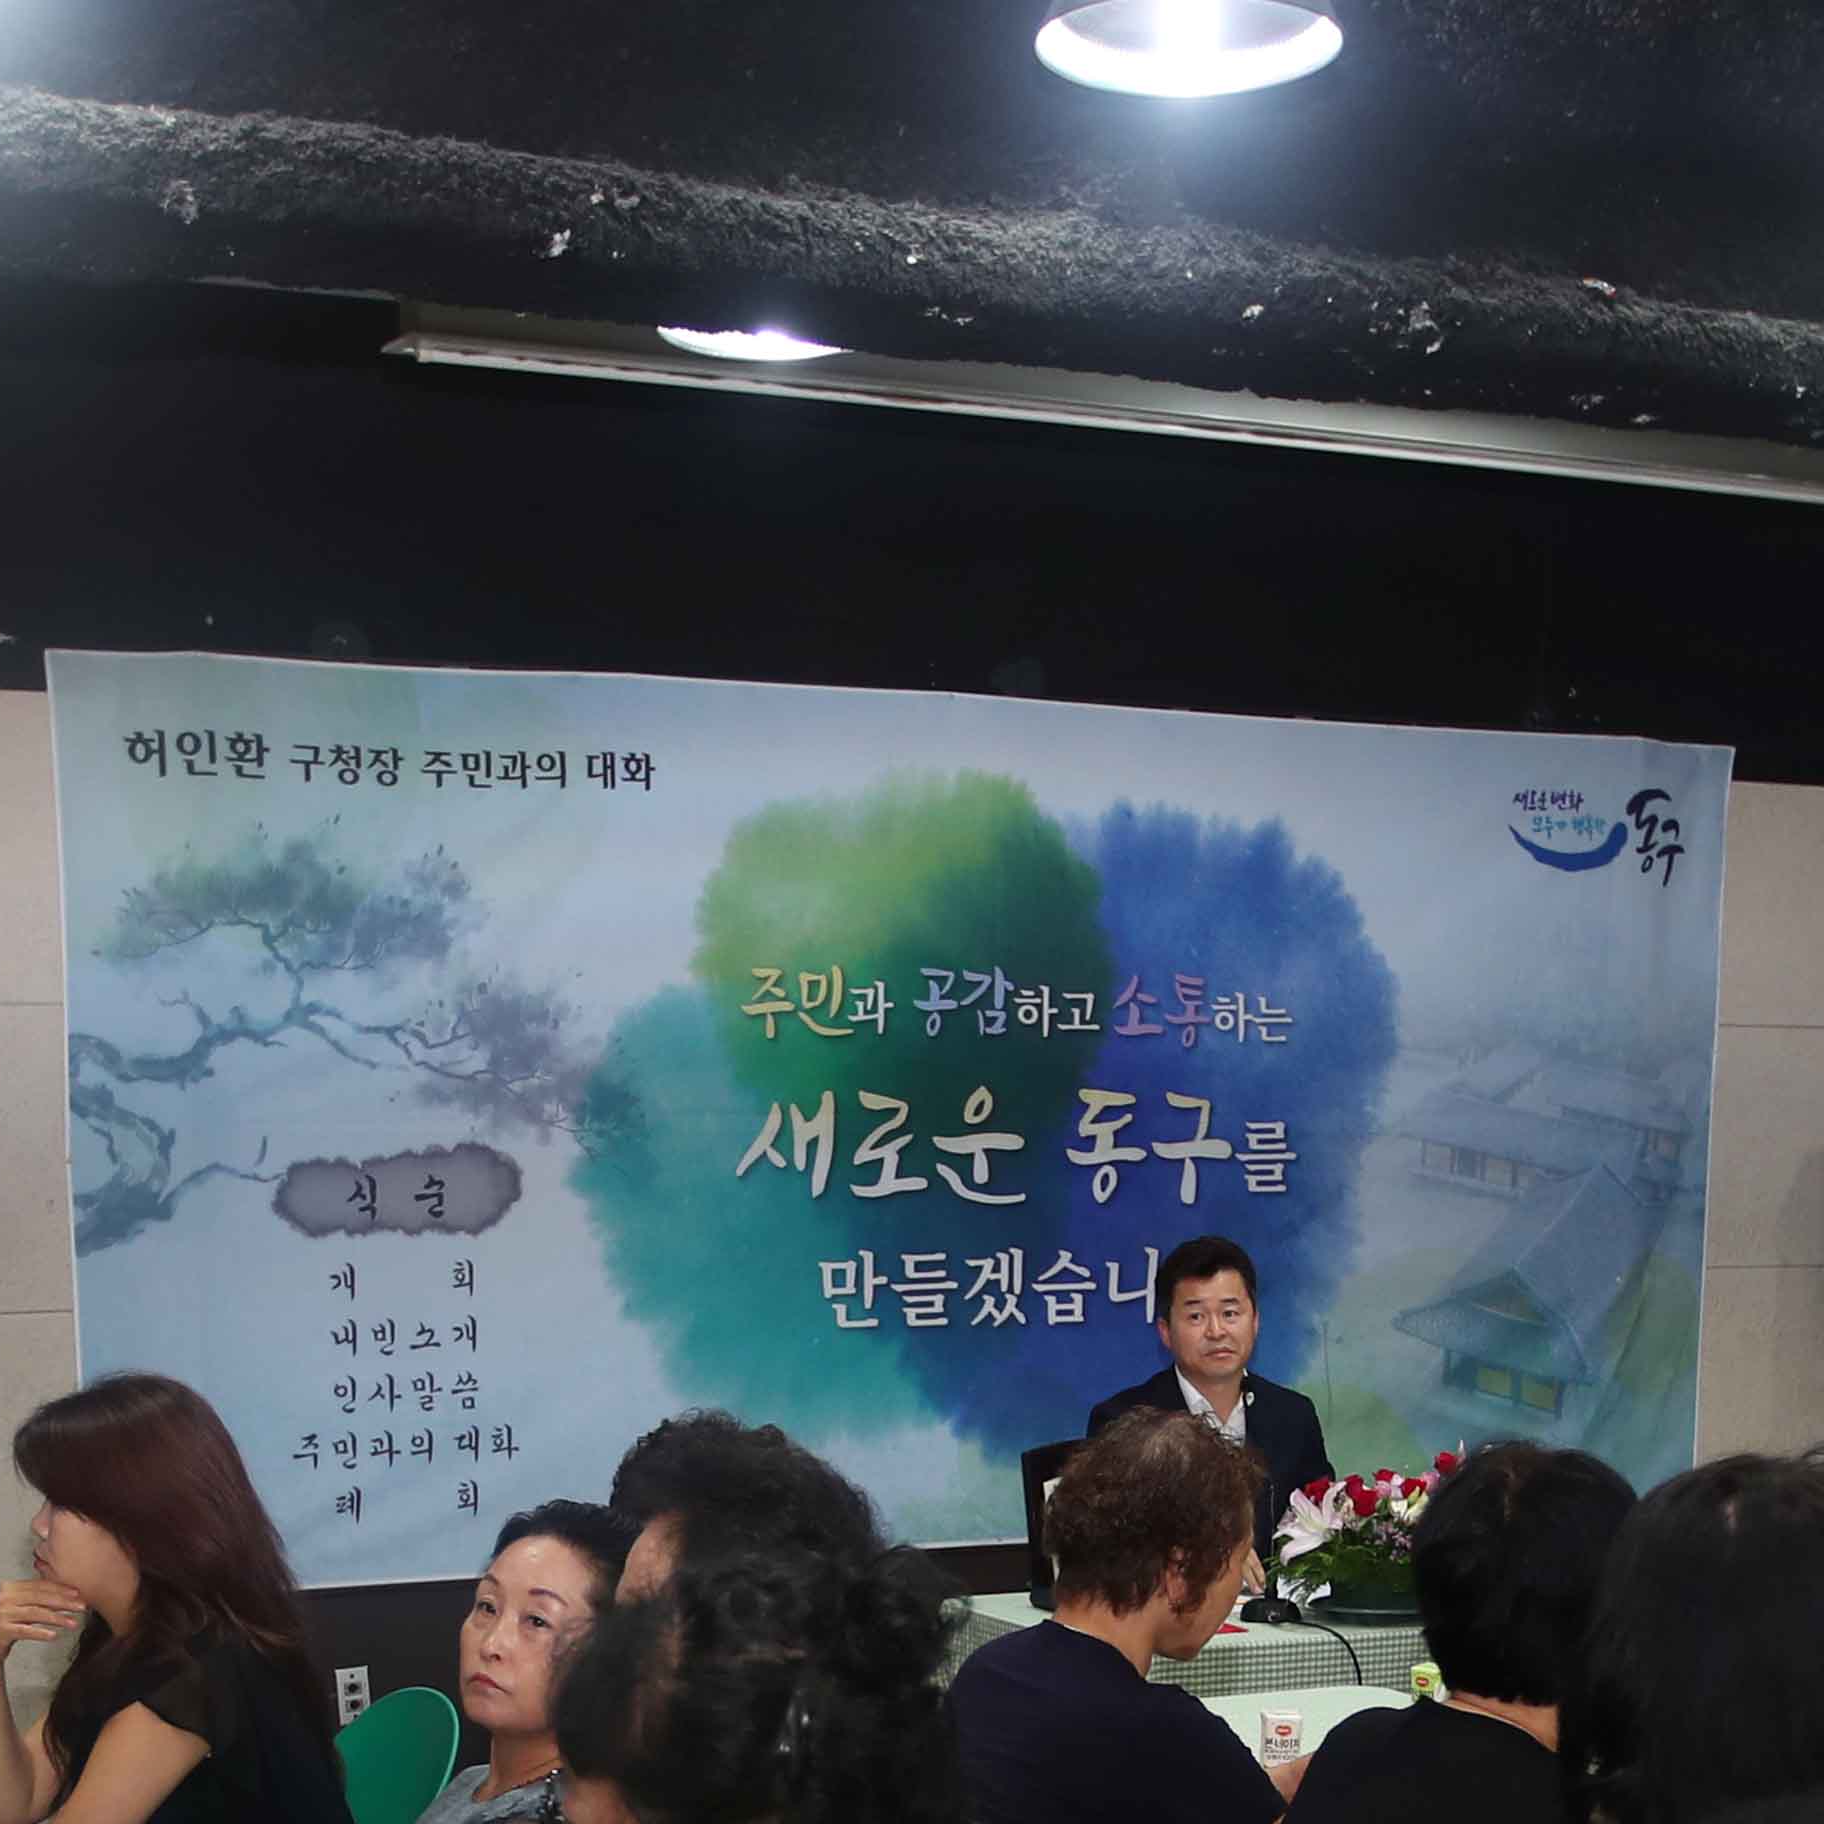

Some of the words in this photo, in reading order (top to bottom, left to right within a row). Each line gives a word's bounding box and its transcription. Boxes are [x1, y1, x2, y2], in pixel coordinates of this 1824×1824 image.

[123, 728, 270, 781] 허인환
[289, 743, 404, 789] 구청장
[421, 750, 567, 790] 주민과의
[586, 751, 656, 791] 대화
[741, 965, 895, 1039] 주민과
[913, 966, 1100, 1039] 공감하고
[1113, 973, 1294, 1049] 소통하는
[736, 1086, 1026, 1204] 새로운
[1066, 1088, 1297, 1204] 동구를
[347, 1174, 376, 1219] 식
[330, 1263, 356, 1299] 개
[452, 1258, 474, 1296] 회
[818, 1246, 1159, 1329] 만들겠습니
[330, 1316, 477, 1357] 내빈소개
[333, 1371, 479, 1412] 인사말씀
[293, 1430, 435, 1470] 주민과의
[453, 1424, 520, 1462] 대화
[335, 1486, 361, 1524] 폐
[457, 1480, 479, 1517] 회
